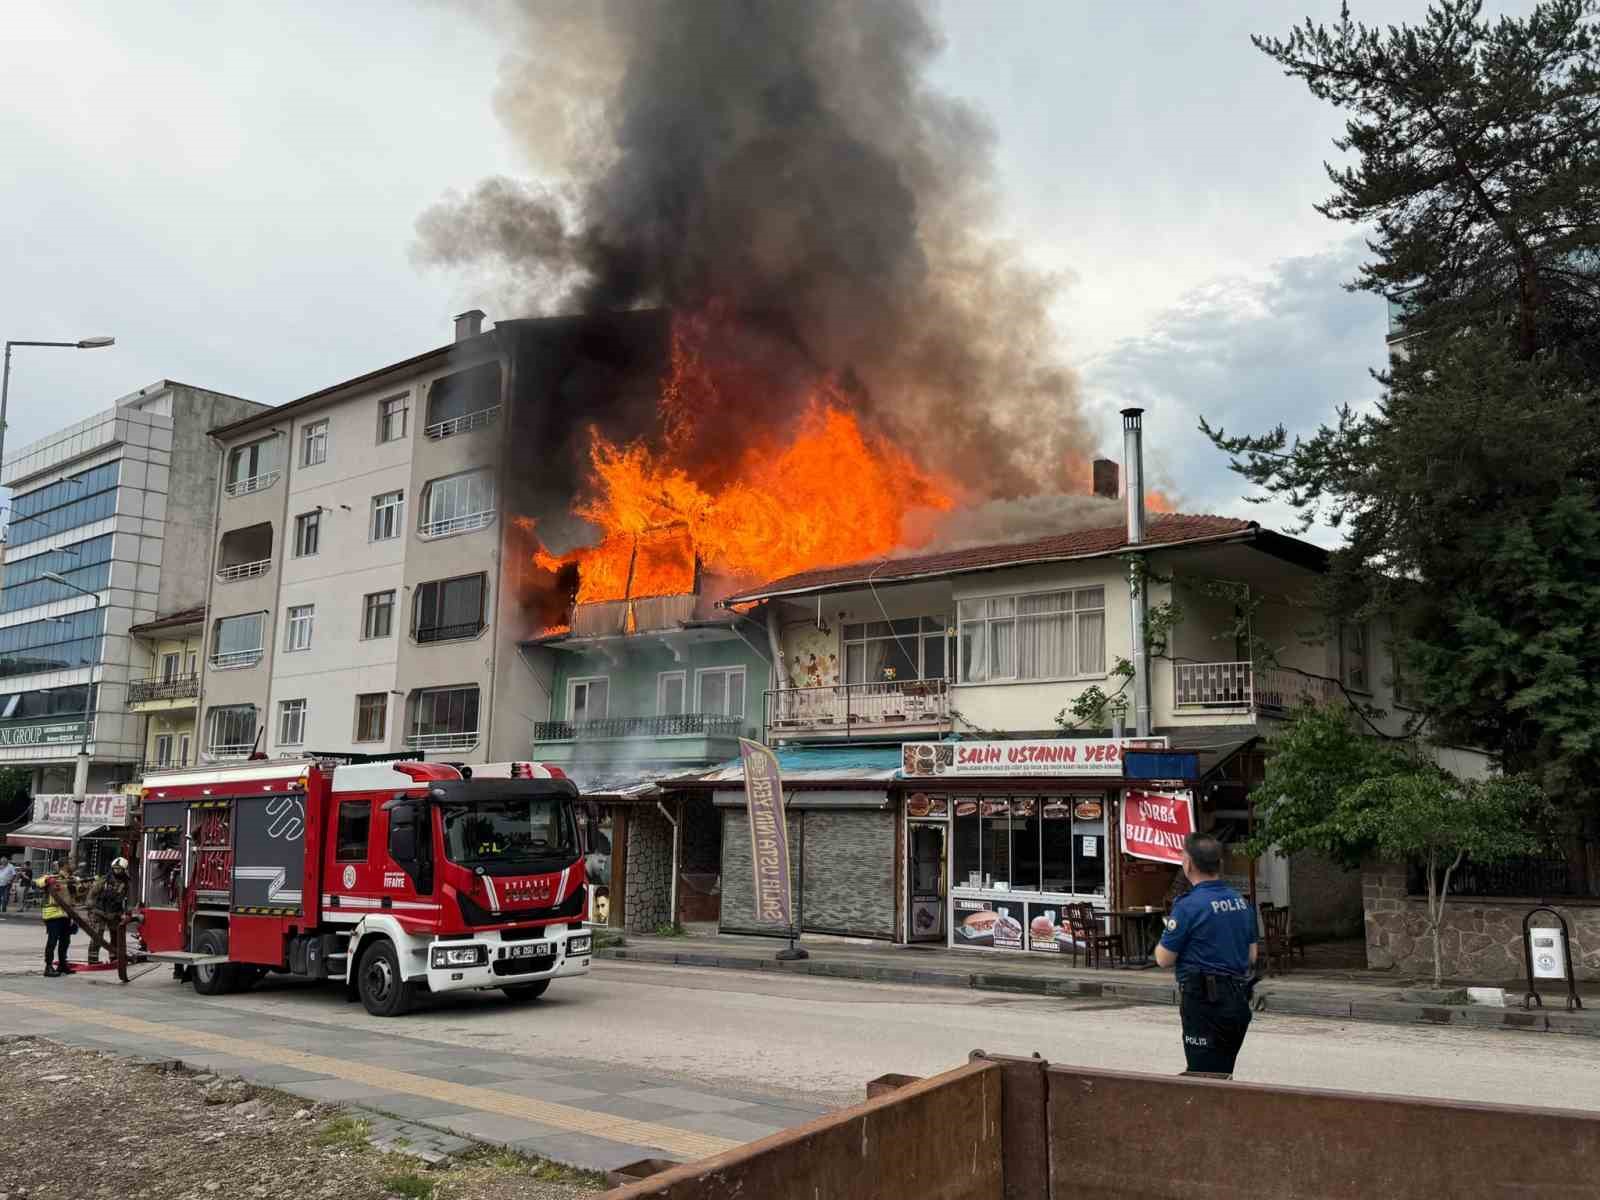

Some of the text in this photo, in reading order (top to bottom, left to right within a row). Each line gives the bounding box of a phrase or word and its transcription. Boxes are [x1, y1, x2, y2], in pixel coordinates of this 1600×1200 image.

[13, 728, 42, 744] GROUP
[957, 744, 1002, 764] SALİH
[1007, 744, 1077, 764] USTANIN
[1126, 823, 1185, 850] BULUNU
[1211, 898, 1248, 913] POLİS
